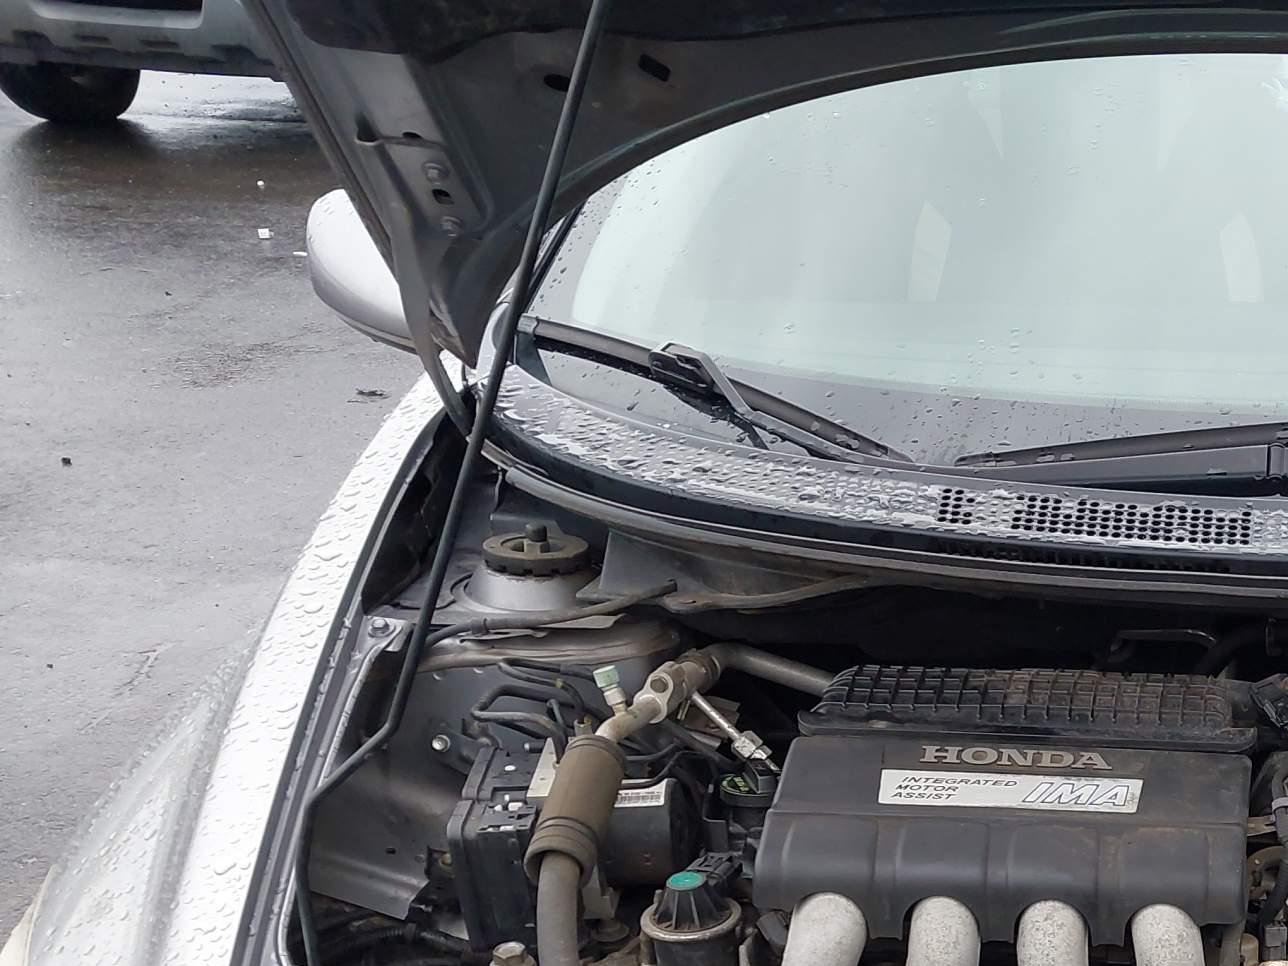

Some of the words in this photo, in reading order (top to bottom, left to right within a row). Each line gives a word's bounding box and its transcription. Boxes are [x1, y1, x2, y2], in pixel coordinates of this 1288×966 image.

[919, 745, 1112, 770] HONDA
[902, 776, 1017, 787] INTEGRATED
[896, 784, 959, 793] MOTOR
[891, 792, 957, 801] ASSIST
[1022, 782, 1130, 807] IMA
